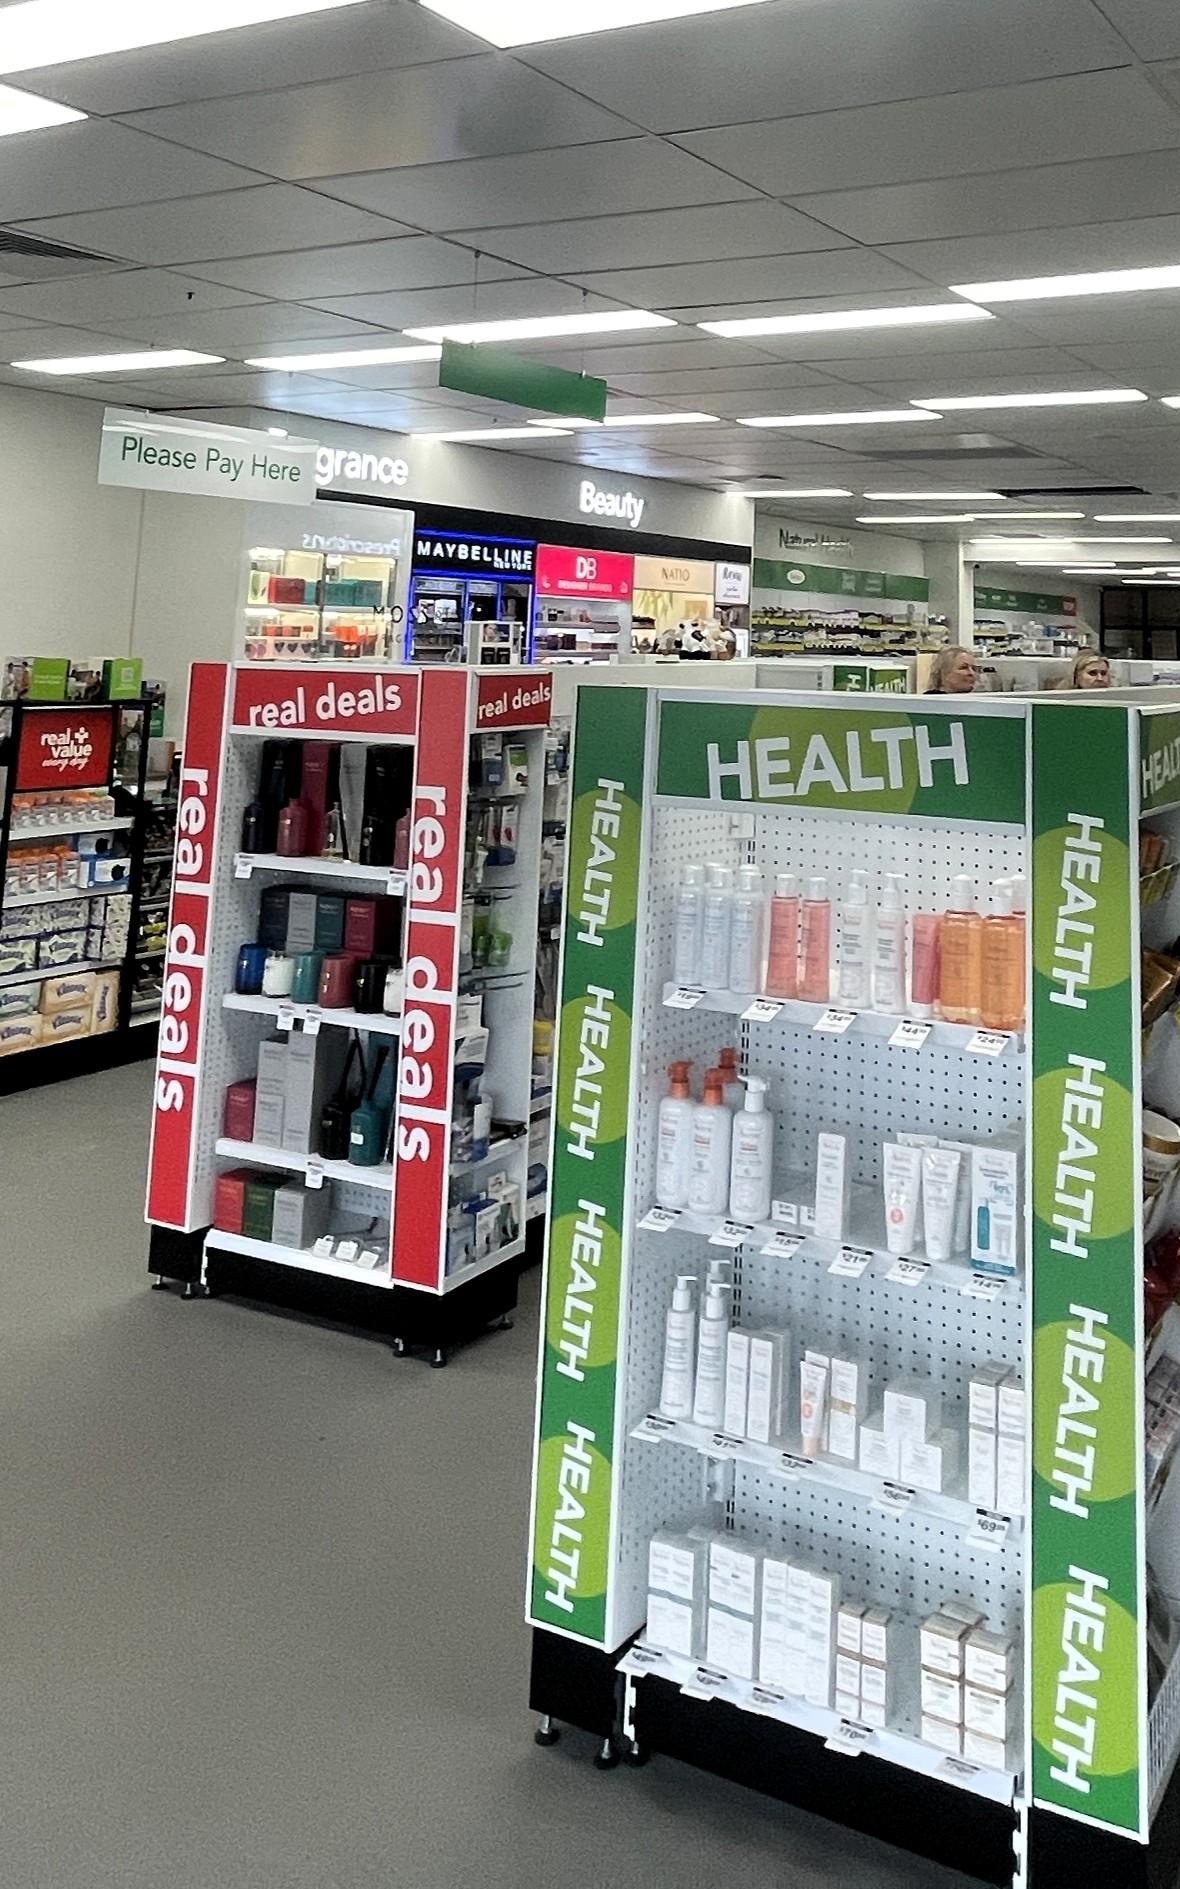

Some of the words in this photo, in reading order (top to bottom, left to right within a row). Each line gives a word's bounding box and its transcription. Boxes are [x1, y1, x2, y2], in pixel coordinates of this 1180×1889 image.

[121, 436, 197, 470] Please
[205, 448, 244, 482] Pay
[251, 454, 301, 482] Here
[580, 481, 645, 529] Beauty
[417, 540, 533, 565] MAYBELLINE
[576, 556, 597, 579] DB
[661, 567, 691, 582] NATIO
[40, 728, 72, 746] real
[51, 743, 93, 758] value
[249, 686, 306, 729] real
[315, 674, 402, 720] deals
[478, 690, 509, 721] real
[512, 681, 553, 709] deals
[707, 722, 970, 801] HEALTH
[174, 767, 211, 896] real
[408, 786, 457, 927] real
[577, 777, 625, 948] HEALTH
[1050, 812, 1105, 1010] HEALTH
[156, 922, 206, 1114] deals
[397, 954, 455, 1163] deals
[567, 984, 615, 1161] HEALTH
[1050, 1054, 1107, 1260] HEALTH
[555, 1199, 606, 1383] HEALTH
[1049, 1303, 1109, 1520] HEALTH
[545, 1421, 597, 1614] HEALTH
[1049, 1564, 1110, 1794] HEALTH
